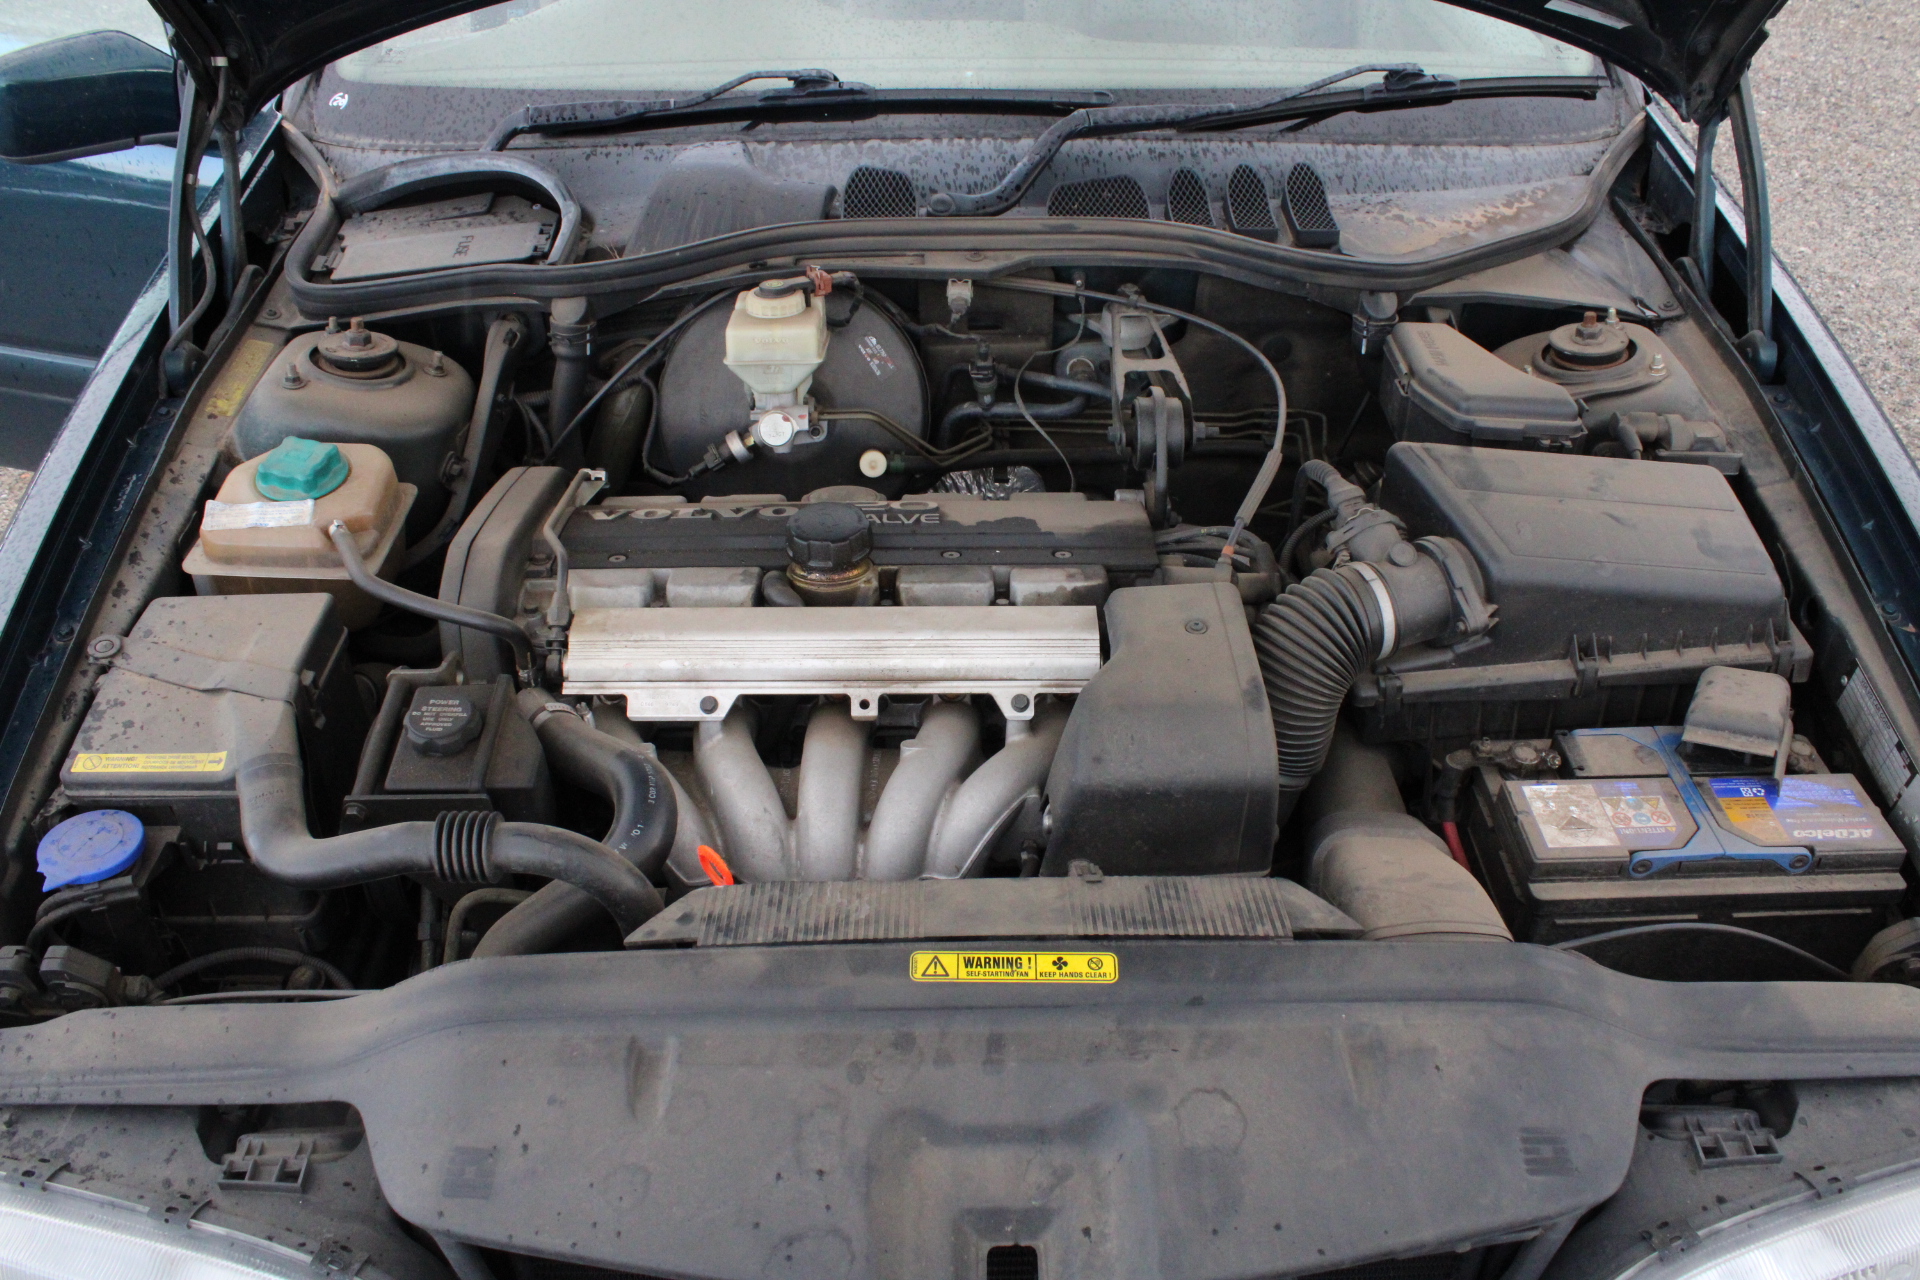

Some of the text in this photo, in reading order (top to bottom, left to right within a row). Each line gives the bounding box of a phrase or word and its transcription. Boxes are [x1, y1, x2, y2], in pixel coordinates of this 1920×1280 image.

[452, 235, 475, 258] FUSE
[587, 506, 799, 520] VOLVO
[866, 513, 940, 524] ALVE
[1793, 828, 1873, 839] ACDelco
[963, 957, 1023, 969] WARNING
[1016, 970, 1029, 978] FAN
